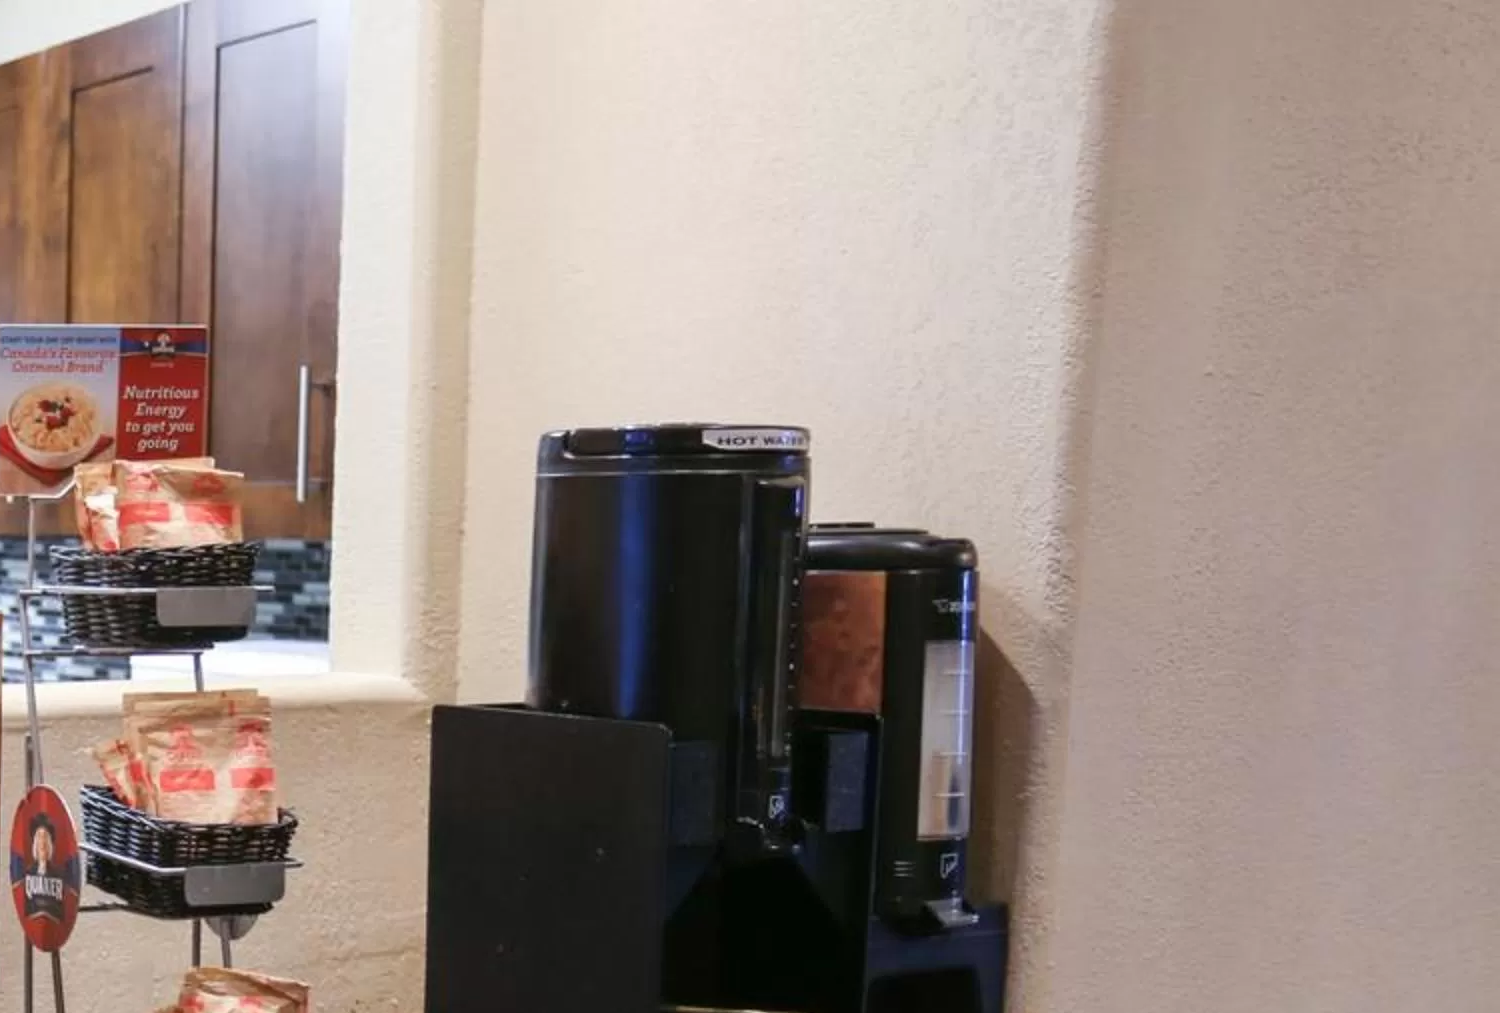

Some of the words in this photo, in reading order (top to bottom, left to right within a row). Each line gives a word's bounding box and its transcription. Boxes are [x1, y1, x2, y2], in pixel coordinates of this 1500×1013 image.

[122, 385, 199, 400] Nutritious
[134, 401, 187, 420] Energy
[125, 421, 141, 433] to
[142, 421, 166, 437] get
[166, 422, 195, 436] you
[137, 437, 179, 453] going
[717, 436, 758, 447] HOT
